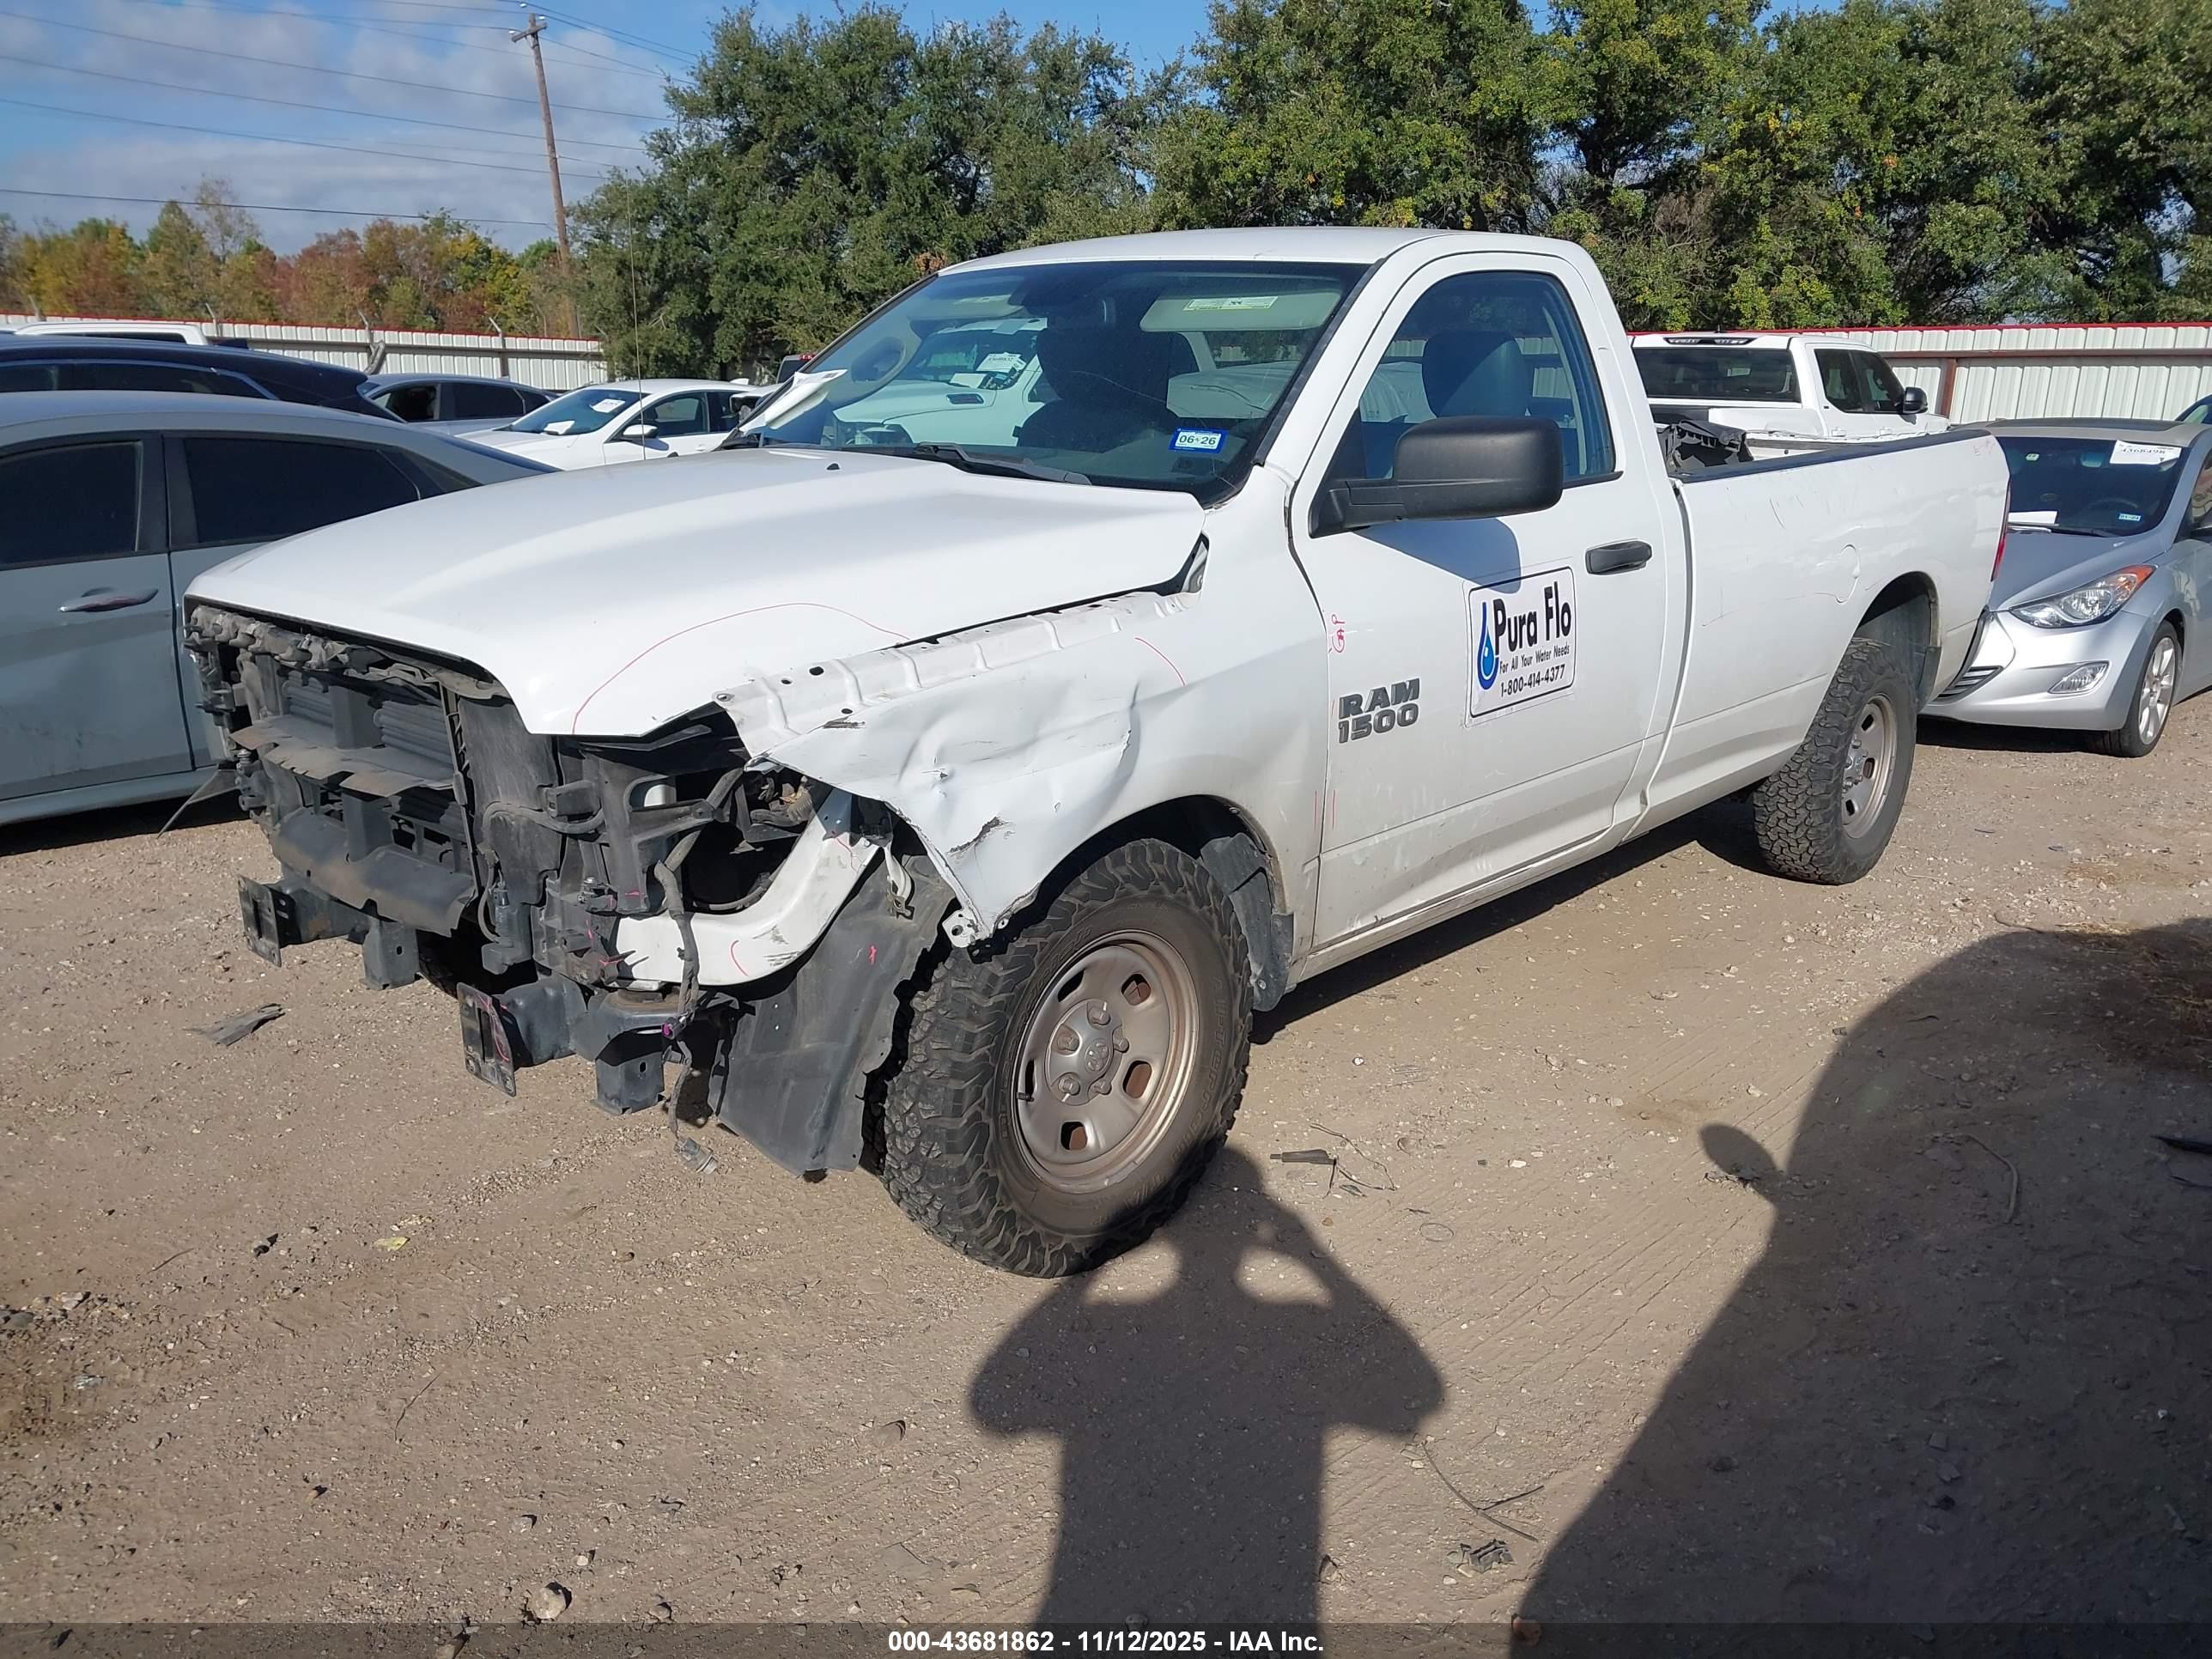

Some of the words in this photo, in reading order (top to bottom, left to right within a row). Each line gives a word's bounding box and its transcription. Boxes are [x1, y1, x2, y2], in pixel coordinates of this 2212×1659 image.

[1493, 599, 1538, 655] Pura
[1544, 581, 1571, 641] Flo
[1499, 661, 1509, 674] For
[1521, 654, 1534, 667] Your
[1534, 650, 1552, 663] Water
[1553, 641, 1570, 658] Needs
[1339, 678, 1421, 719] RAM
[1500, 664, 1566, 697] 1-800-414-4377
[1339, 703, 1420, 744] 1500
